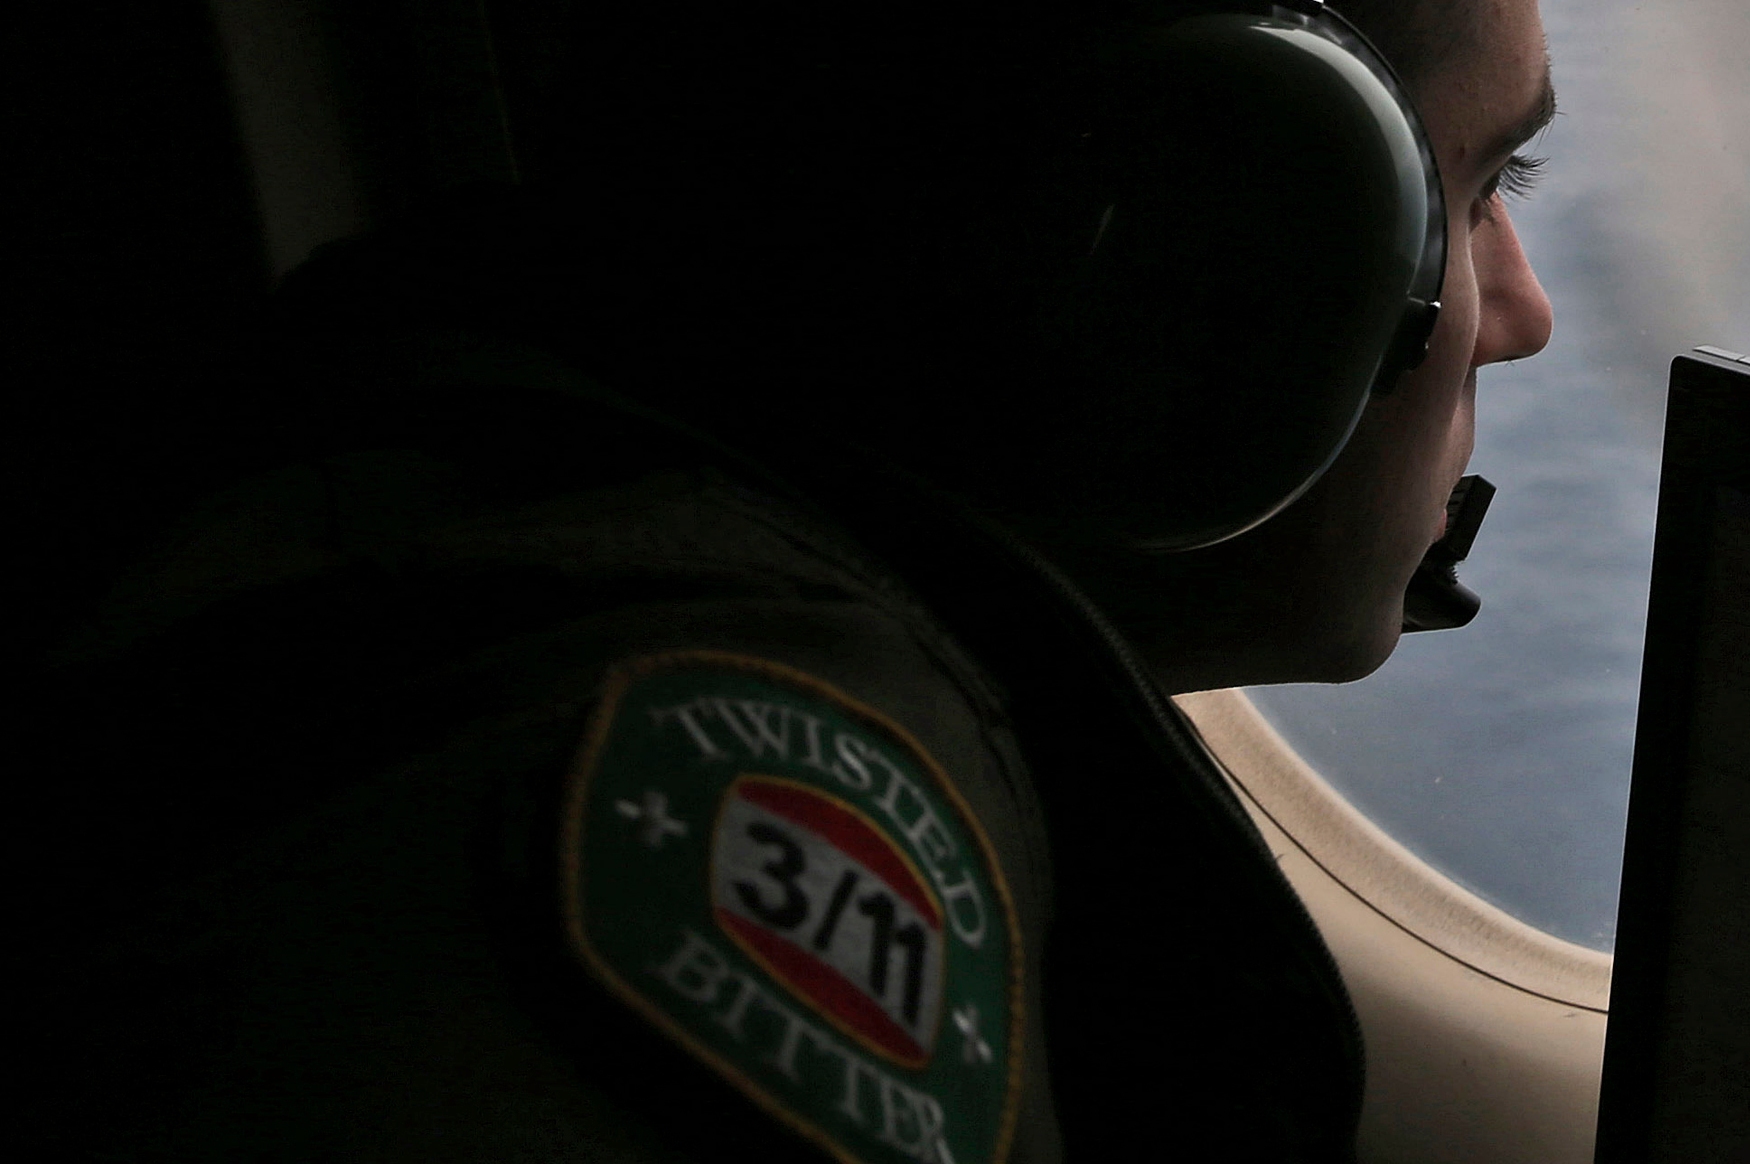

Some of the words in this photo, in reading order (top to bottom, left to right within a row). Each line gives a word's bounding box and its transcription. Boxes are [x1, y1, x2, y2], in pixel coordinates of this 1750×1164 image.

[648, 696, 988, 949] TWISTED
[734, 821, 926, 1022] 3/11
[644, 928, 956, 1164] BITTER
